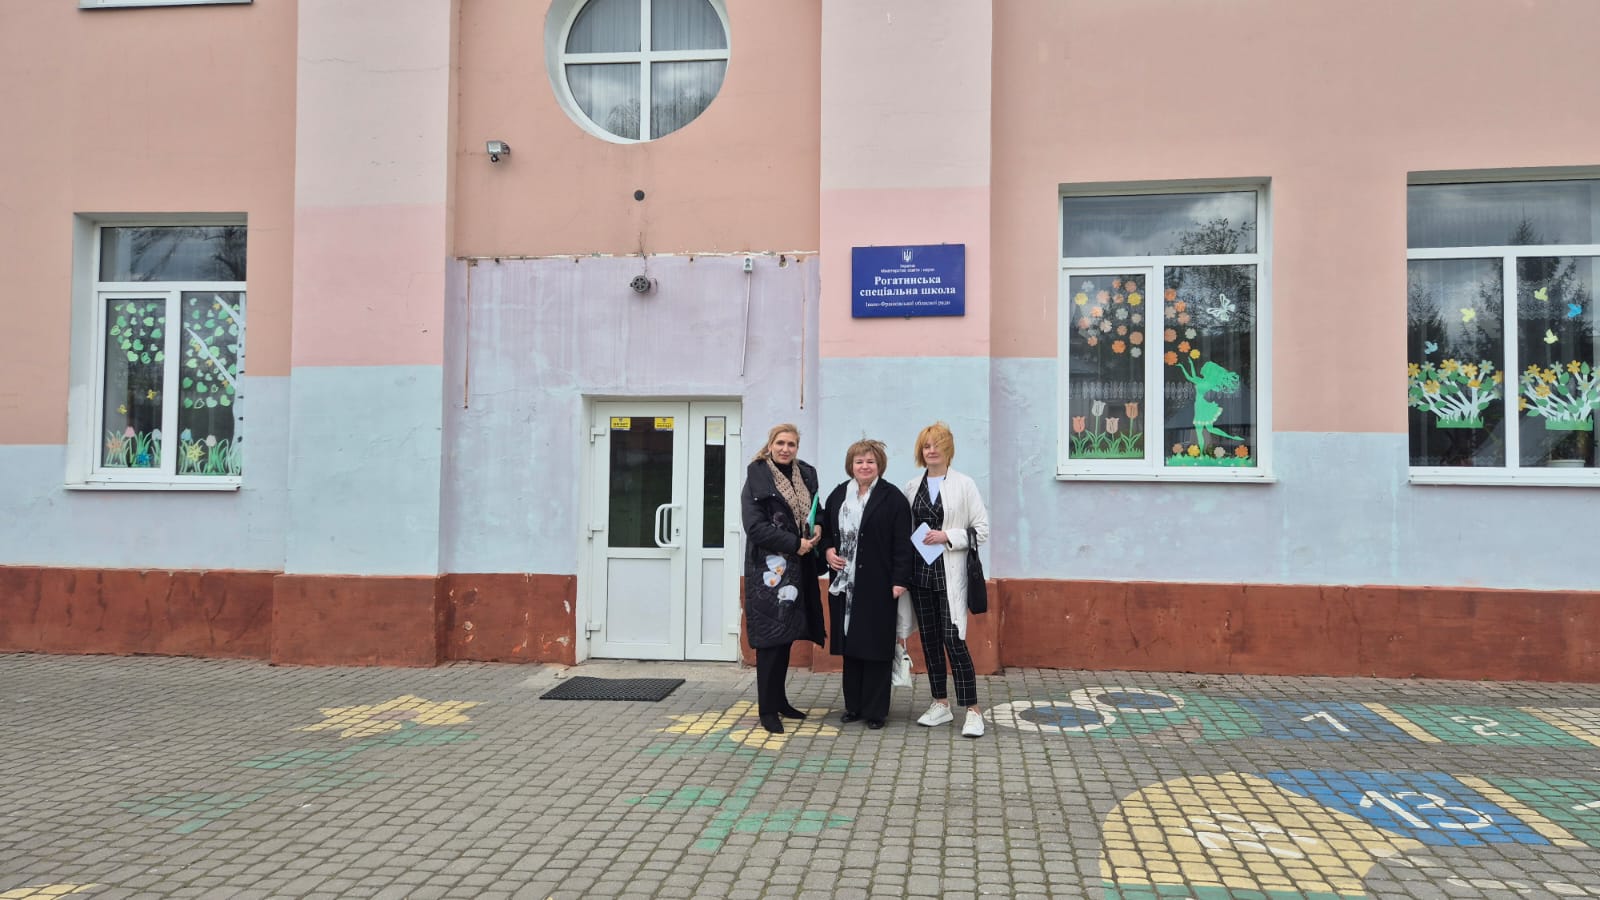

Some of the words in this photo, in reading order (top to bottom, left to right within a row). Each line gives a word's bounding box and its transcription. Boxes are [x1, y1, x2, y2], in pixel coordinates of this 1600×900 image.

[874, 276, 941, 285] Рогатинська
[860, 287, 918, 296] спеціальна
[1301, 711, 1349, 732] 1
[1359, 790, 1493, 829] 13
